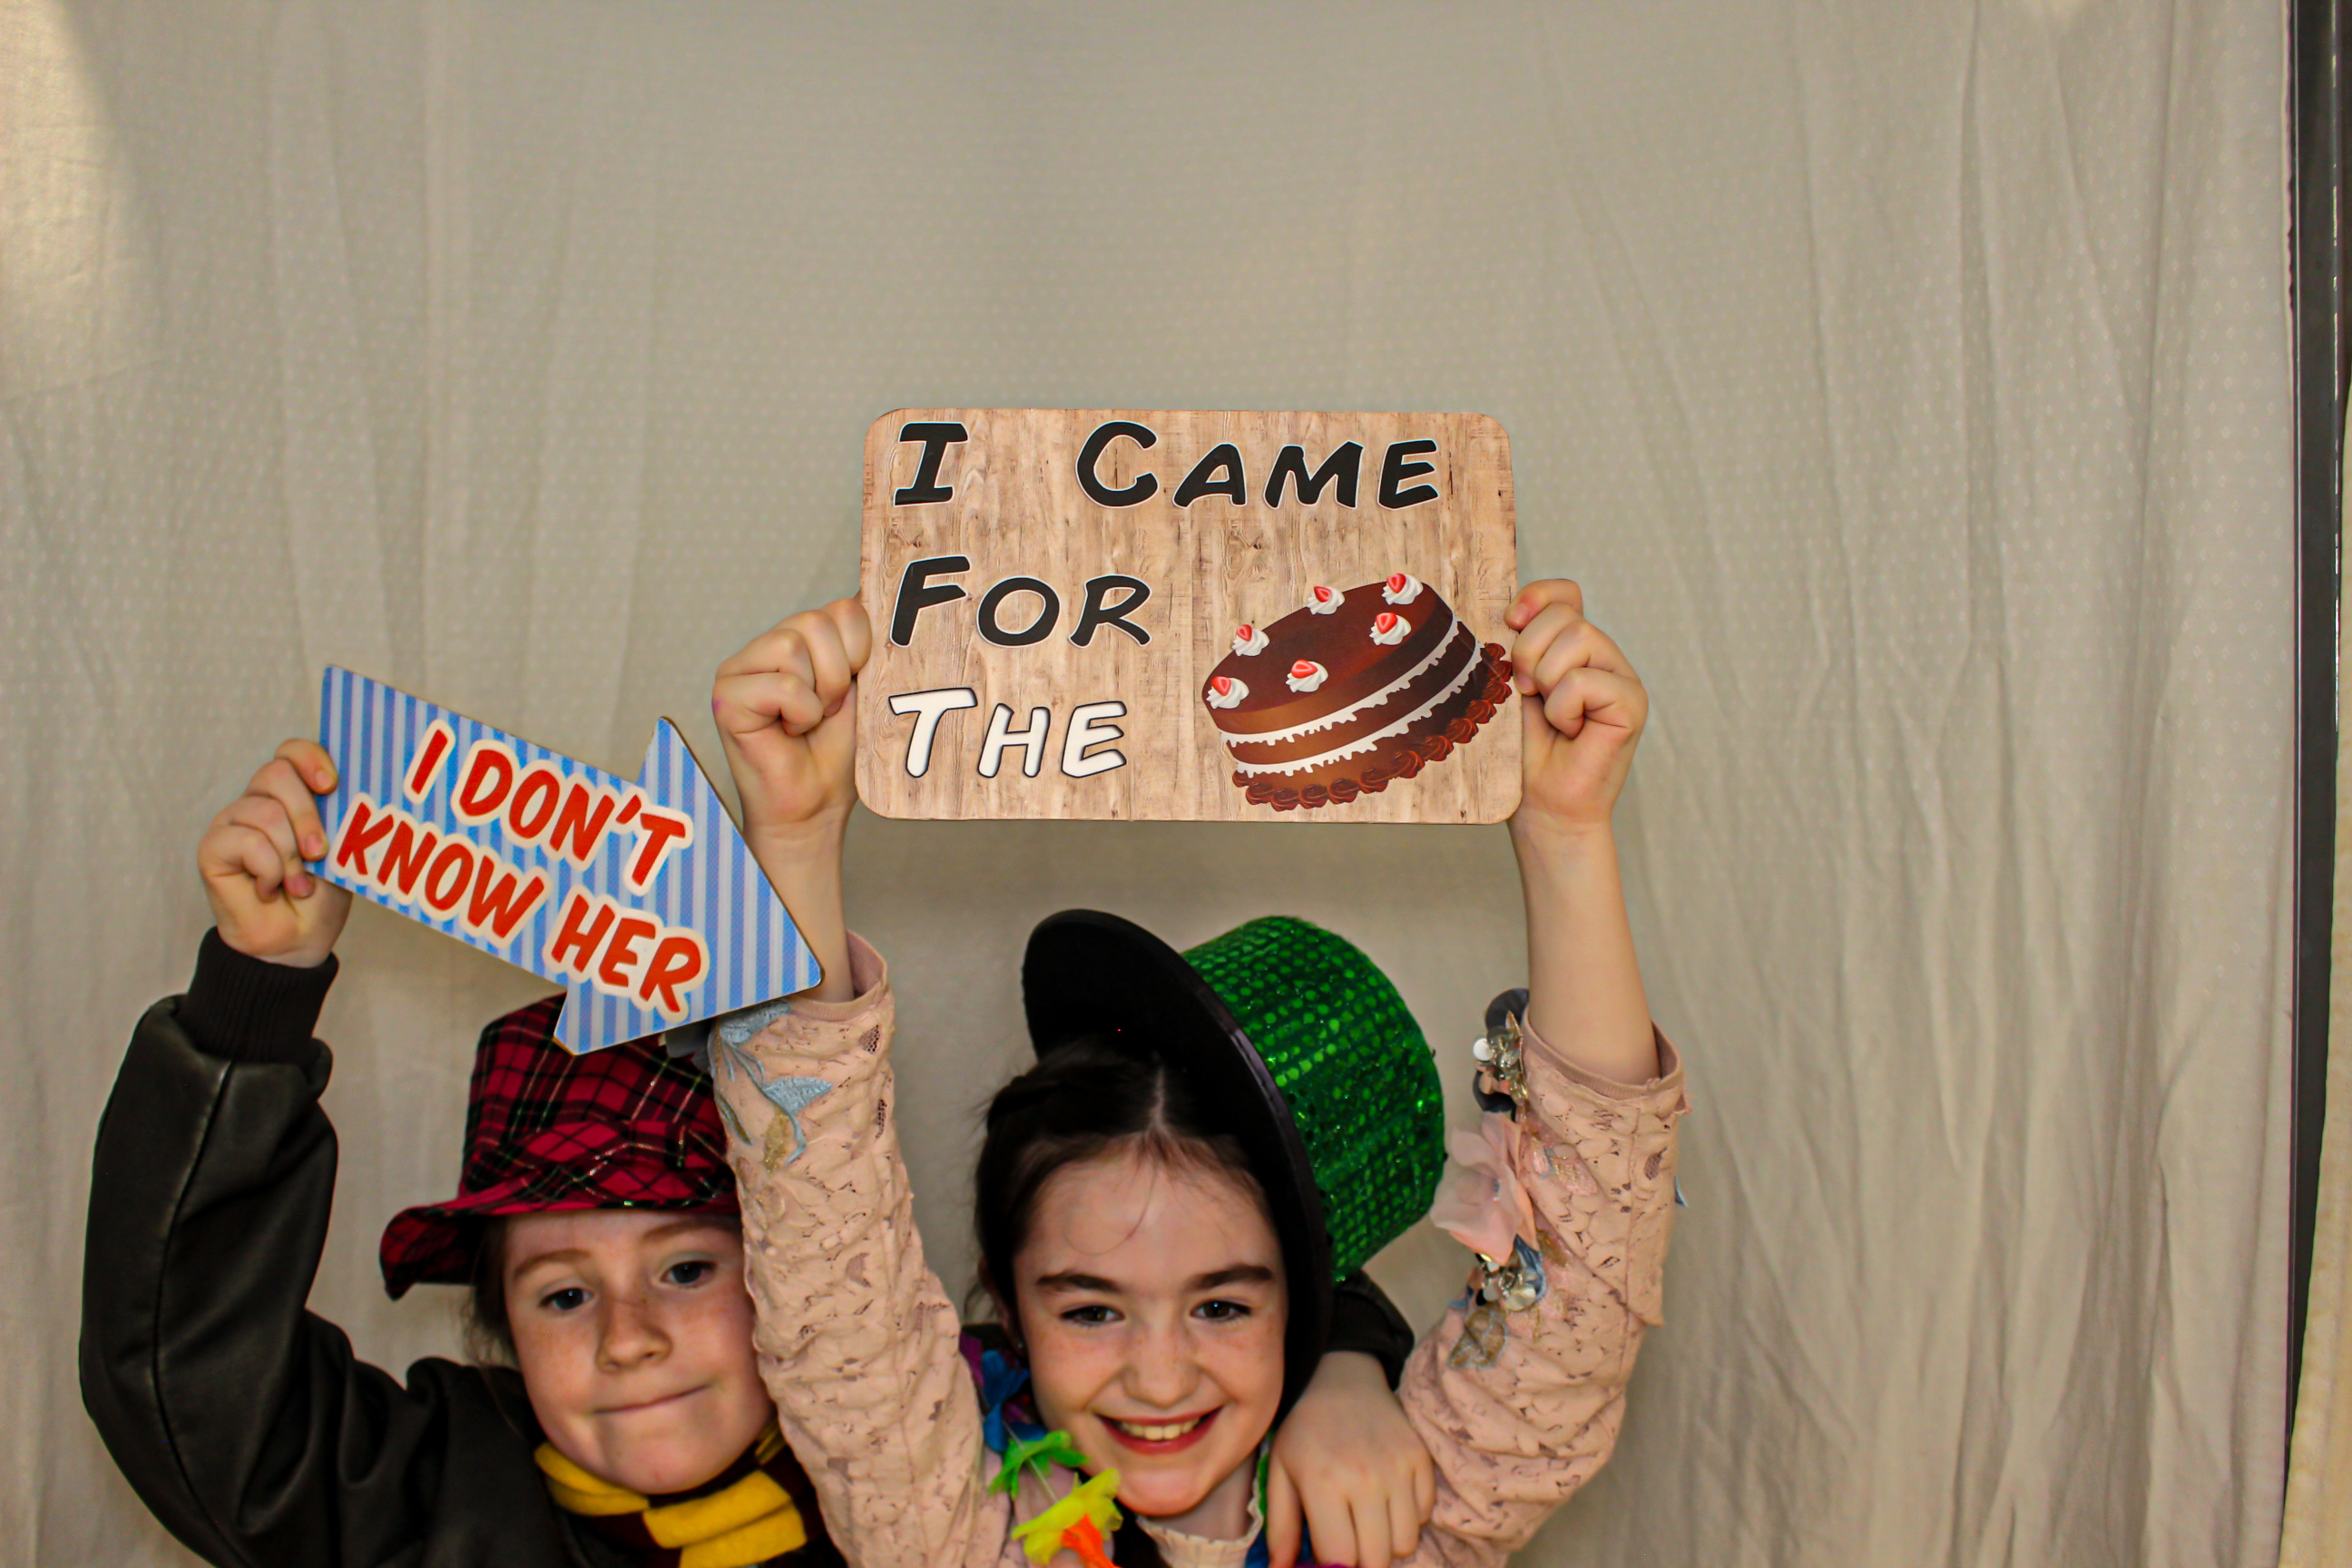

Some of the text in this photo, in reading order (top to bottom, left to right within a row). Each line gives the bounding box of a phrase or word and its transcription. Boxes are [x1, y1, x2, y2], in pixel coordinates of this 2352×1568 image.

[894, 421, 1439, 509] I CAME
[889, 555, 1152, 647] FOR
[888, 688, 1127, 778] THE
[411, 729, 686, 887] I DON'T
[336, 802, 701, 1013] KNOW HER
